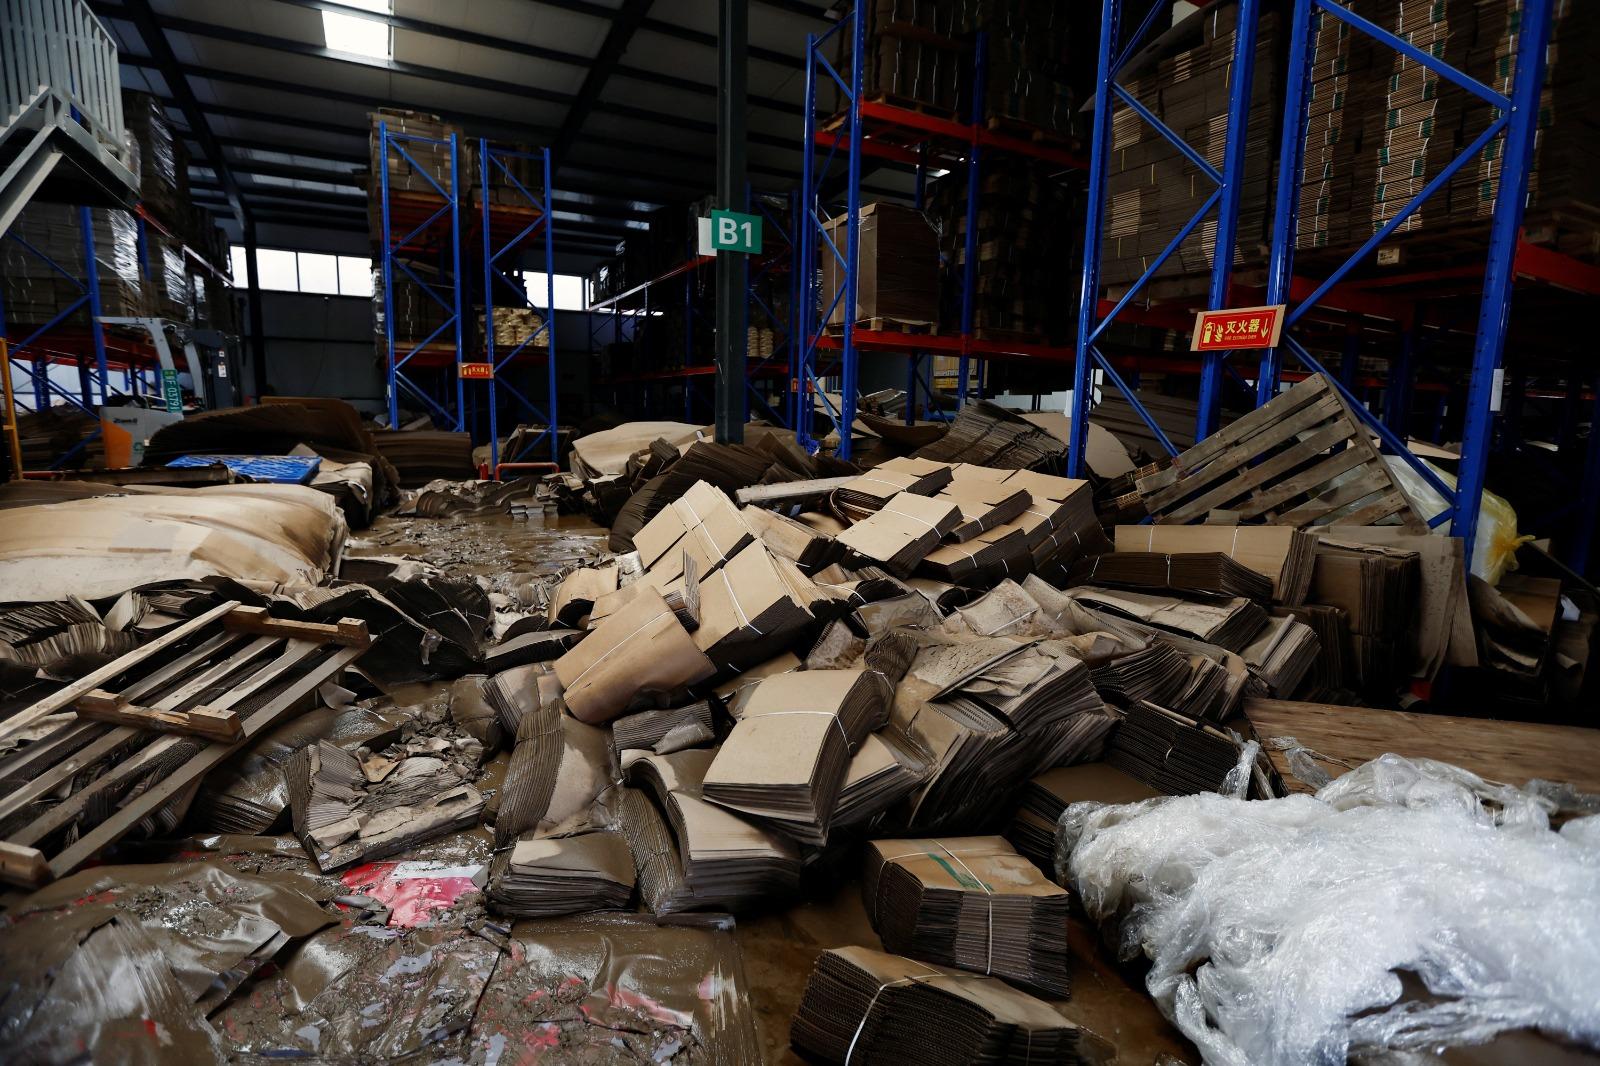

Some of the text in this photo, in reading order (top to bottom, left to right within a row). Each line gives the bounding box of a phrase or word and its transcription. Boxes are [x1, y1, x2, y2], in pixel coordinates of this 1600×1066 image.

[719, 217, 752, 248] B1
[1225, 318, 1261, 334] 灭火器
